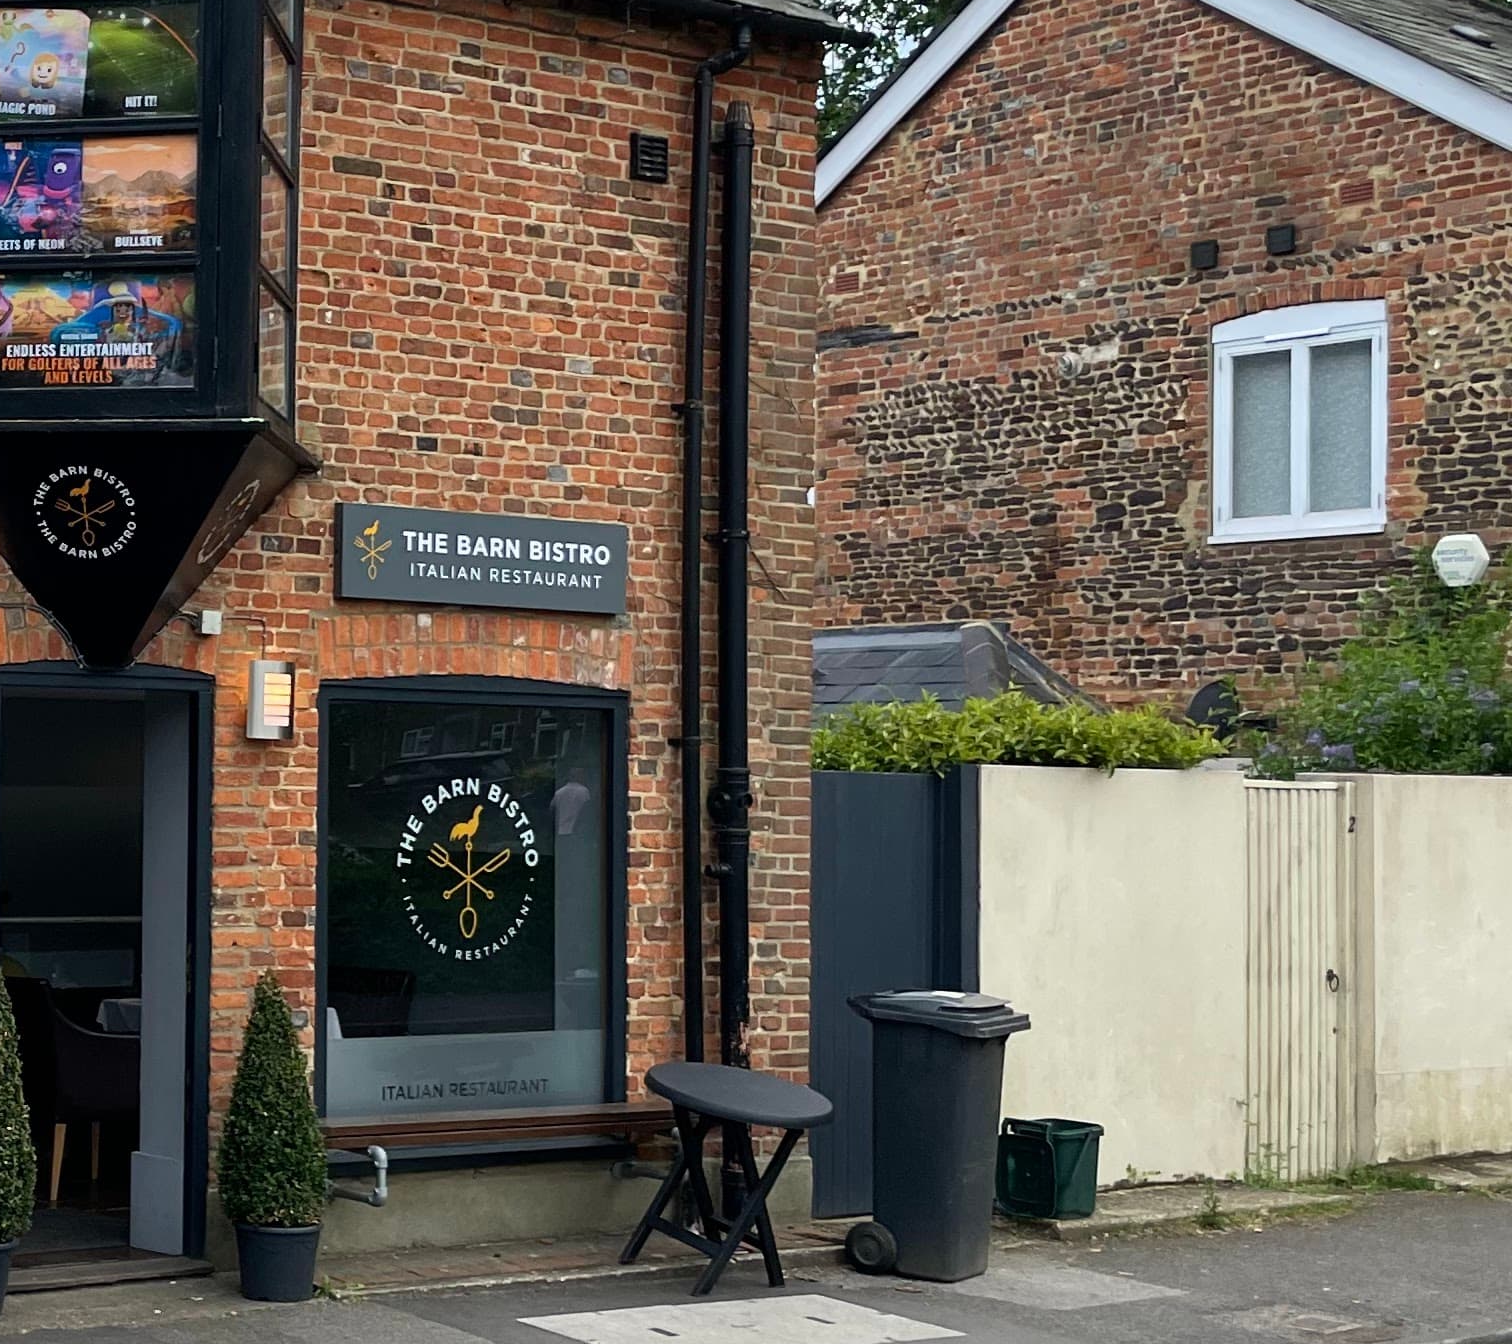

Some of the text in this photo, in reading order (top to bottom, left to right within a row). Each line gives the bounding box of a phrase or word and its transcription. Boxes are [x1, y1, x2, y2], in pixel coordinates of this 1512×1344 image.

[28, 103, 56, 116] POND
[23, 239, 36, 250] OF
[38, 238, 66, 250] NEON
[114, 235, 164, 248] BULLSEYE
[6, 342, 153, 358] ENDLESS ENTERTAINMENT
[1, 356, 157, 371] FOR GOLFERS OF ALL AGES
[44, 370, 113, 384] AND LEVELS
[33, 465, 135, 507] THE BARN BISTRO
[37, 520, 137, 559] THE BARN BISTRO
[402, 530, 611, 566] THE BARN BISTRO
[410, 562, 603, 590] ITALIAN RESTAURANT
[396, 777, 539, 868] THE BARN BISTRO
[1348, 816, 1356, 833] 2
[403, 894, 533, 961] ITALIAN RESTAURANT
[382, 1078, 549, 1102] ITALIAN RESTAURANT
